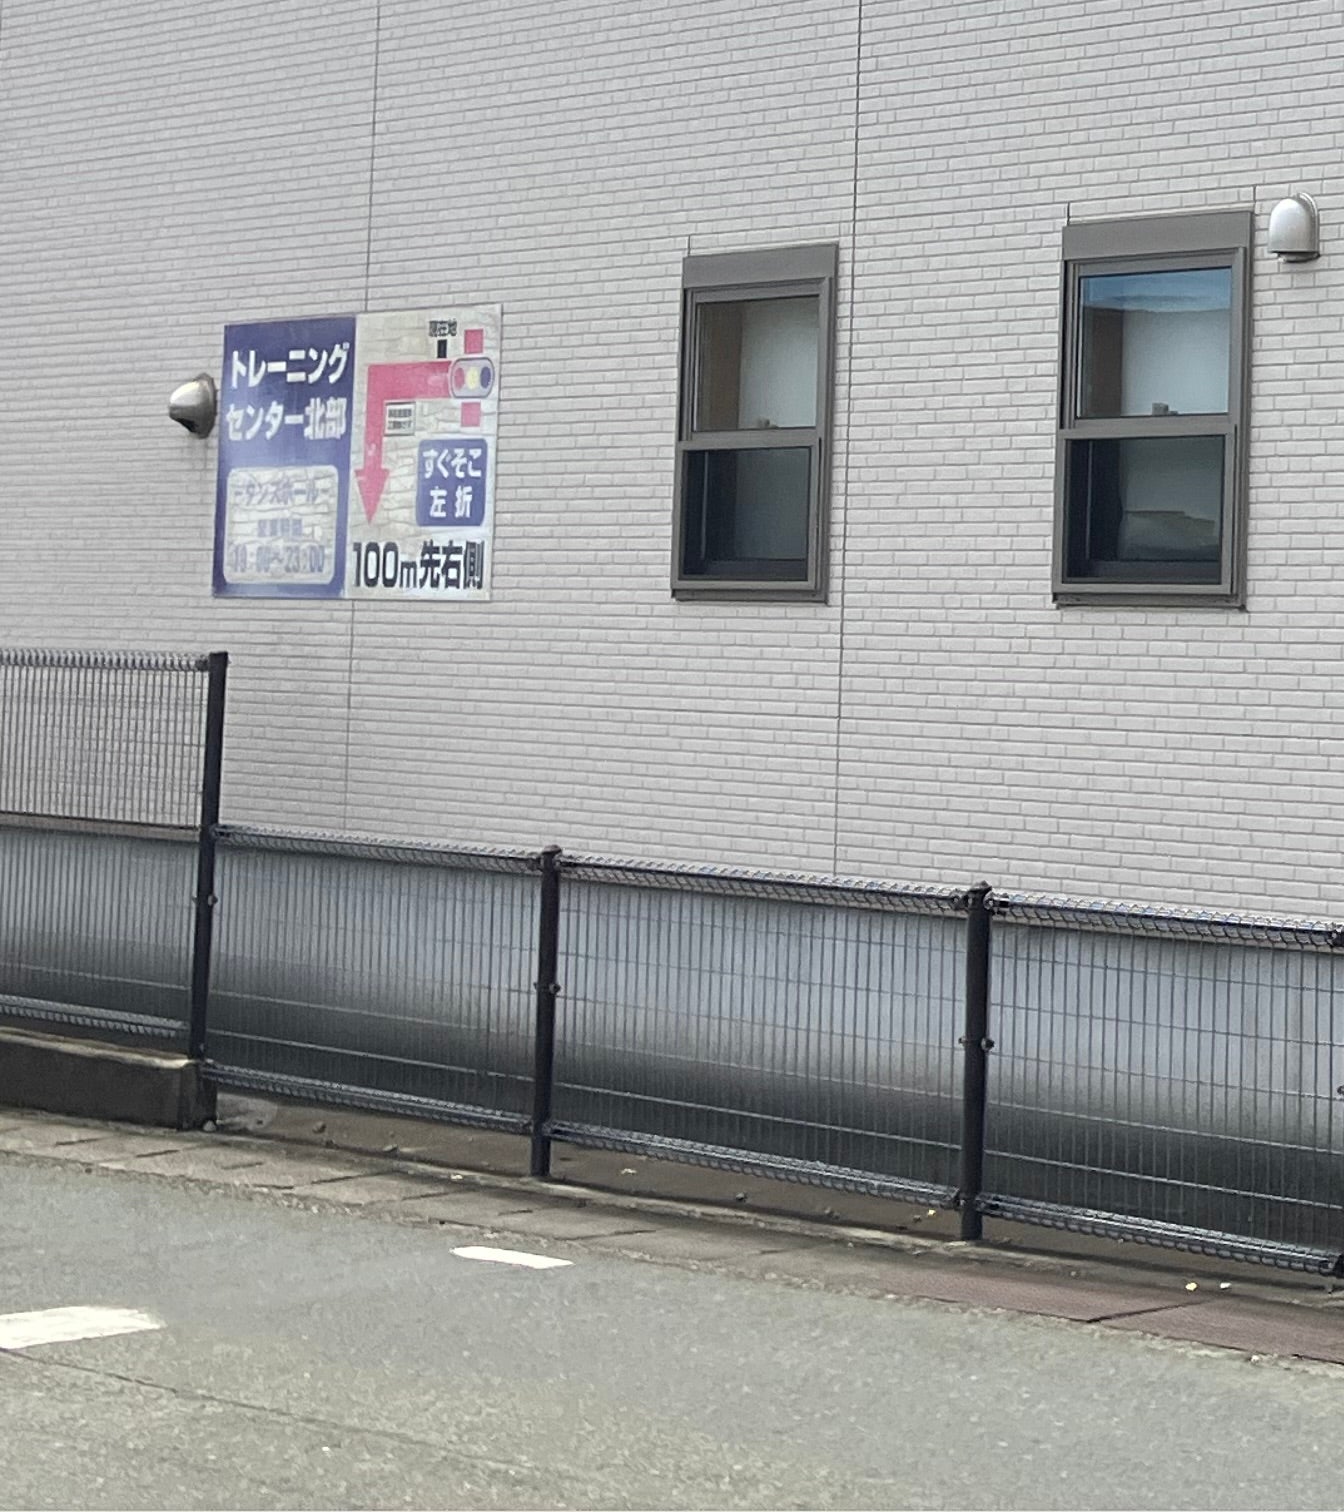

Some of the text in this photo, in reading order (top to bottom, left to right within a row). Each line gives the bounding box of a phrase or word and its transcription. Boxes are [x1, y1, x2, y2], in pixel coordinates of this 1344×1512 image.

[231, 341, 350, 388] トレーニング
[226, 397, 348, 440] センター北部
[422, 446, 482, 478] すぐそこ
[429, 486, 473, 518] 左折
[352, 540, 485, 590] 100m先右側
